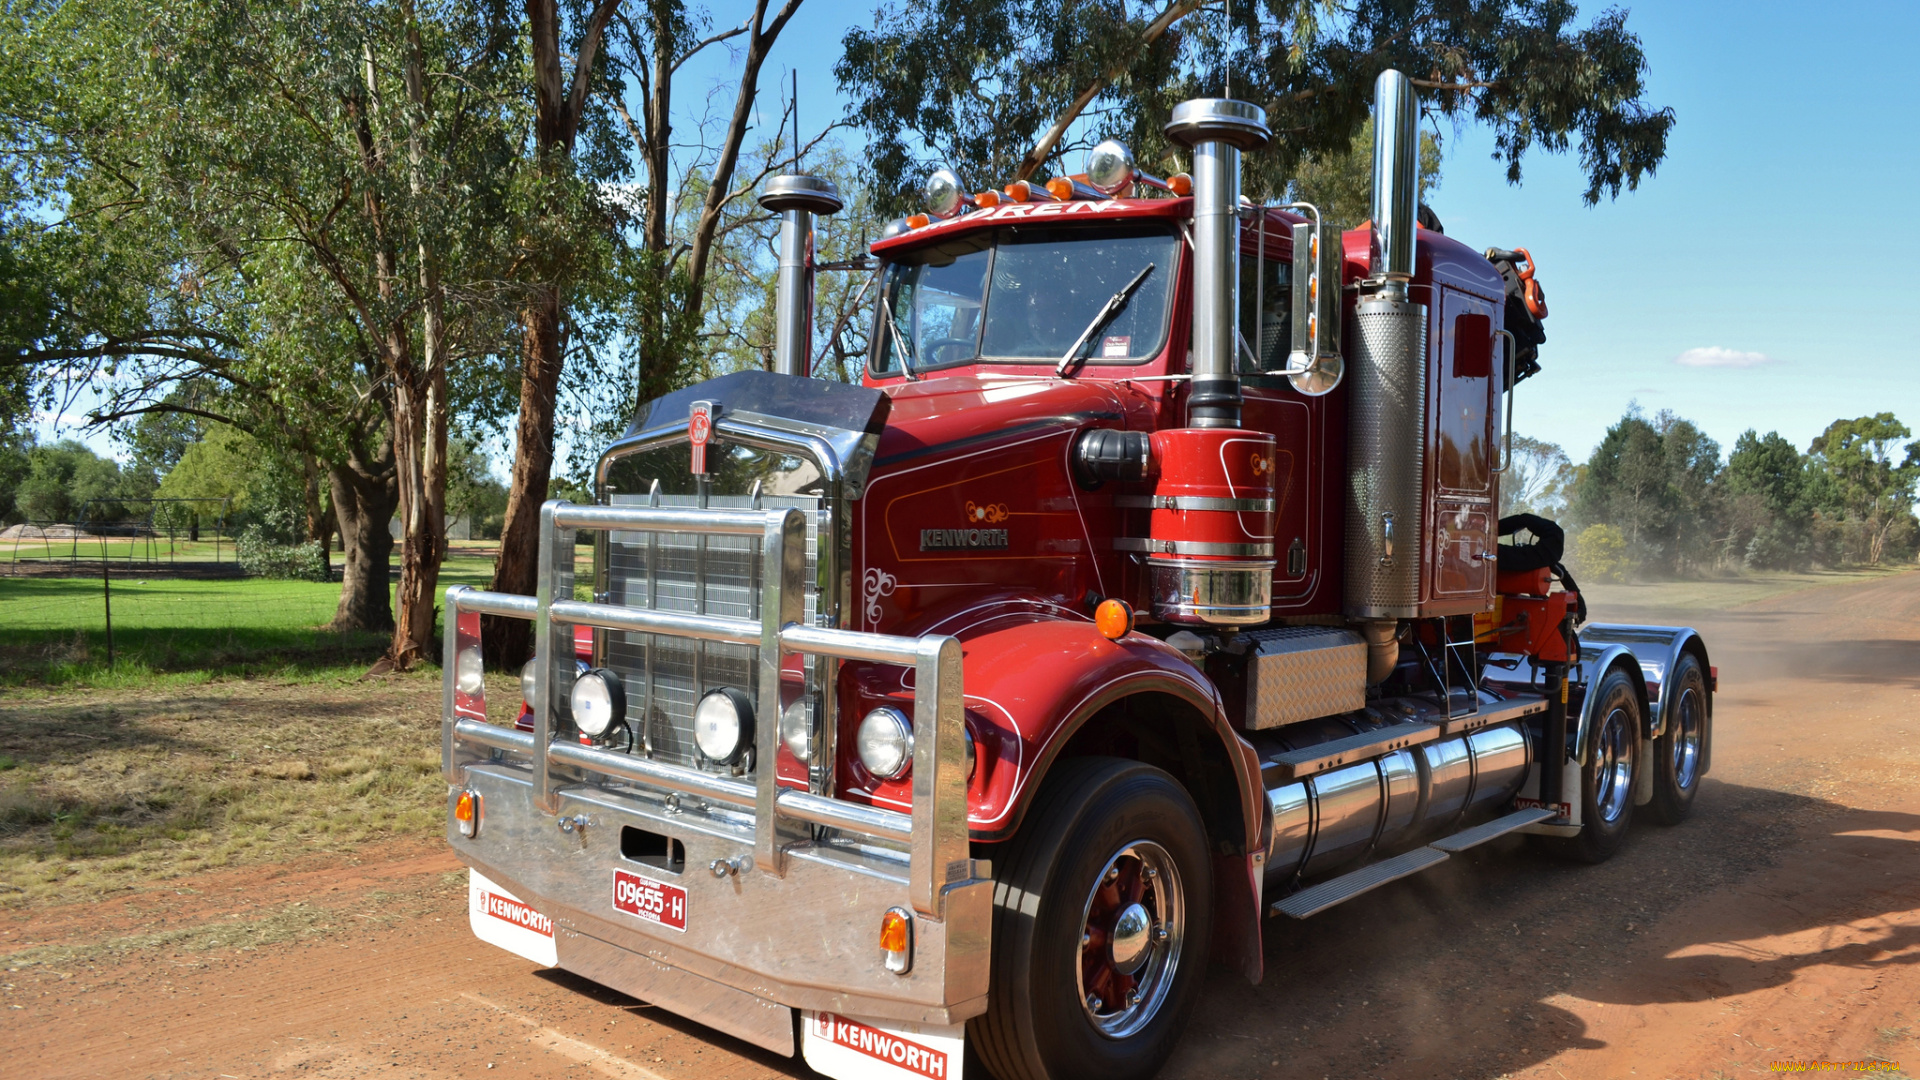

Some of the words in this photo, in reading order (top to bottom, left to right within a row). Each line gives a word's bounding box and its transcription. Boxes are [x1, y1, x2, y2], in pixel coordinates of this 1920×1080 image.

[920, 528, 1008, 547] KENWORTH
[490, 897, 552, 933] KENWORTH
[837, 1022, 943, 1077] KENWORTH
